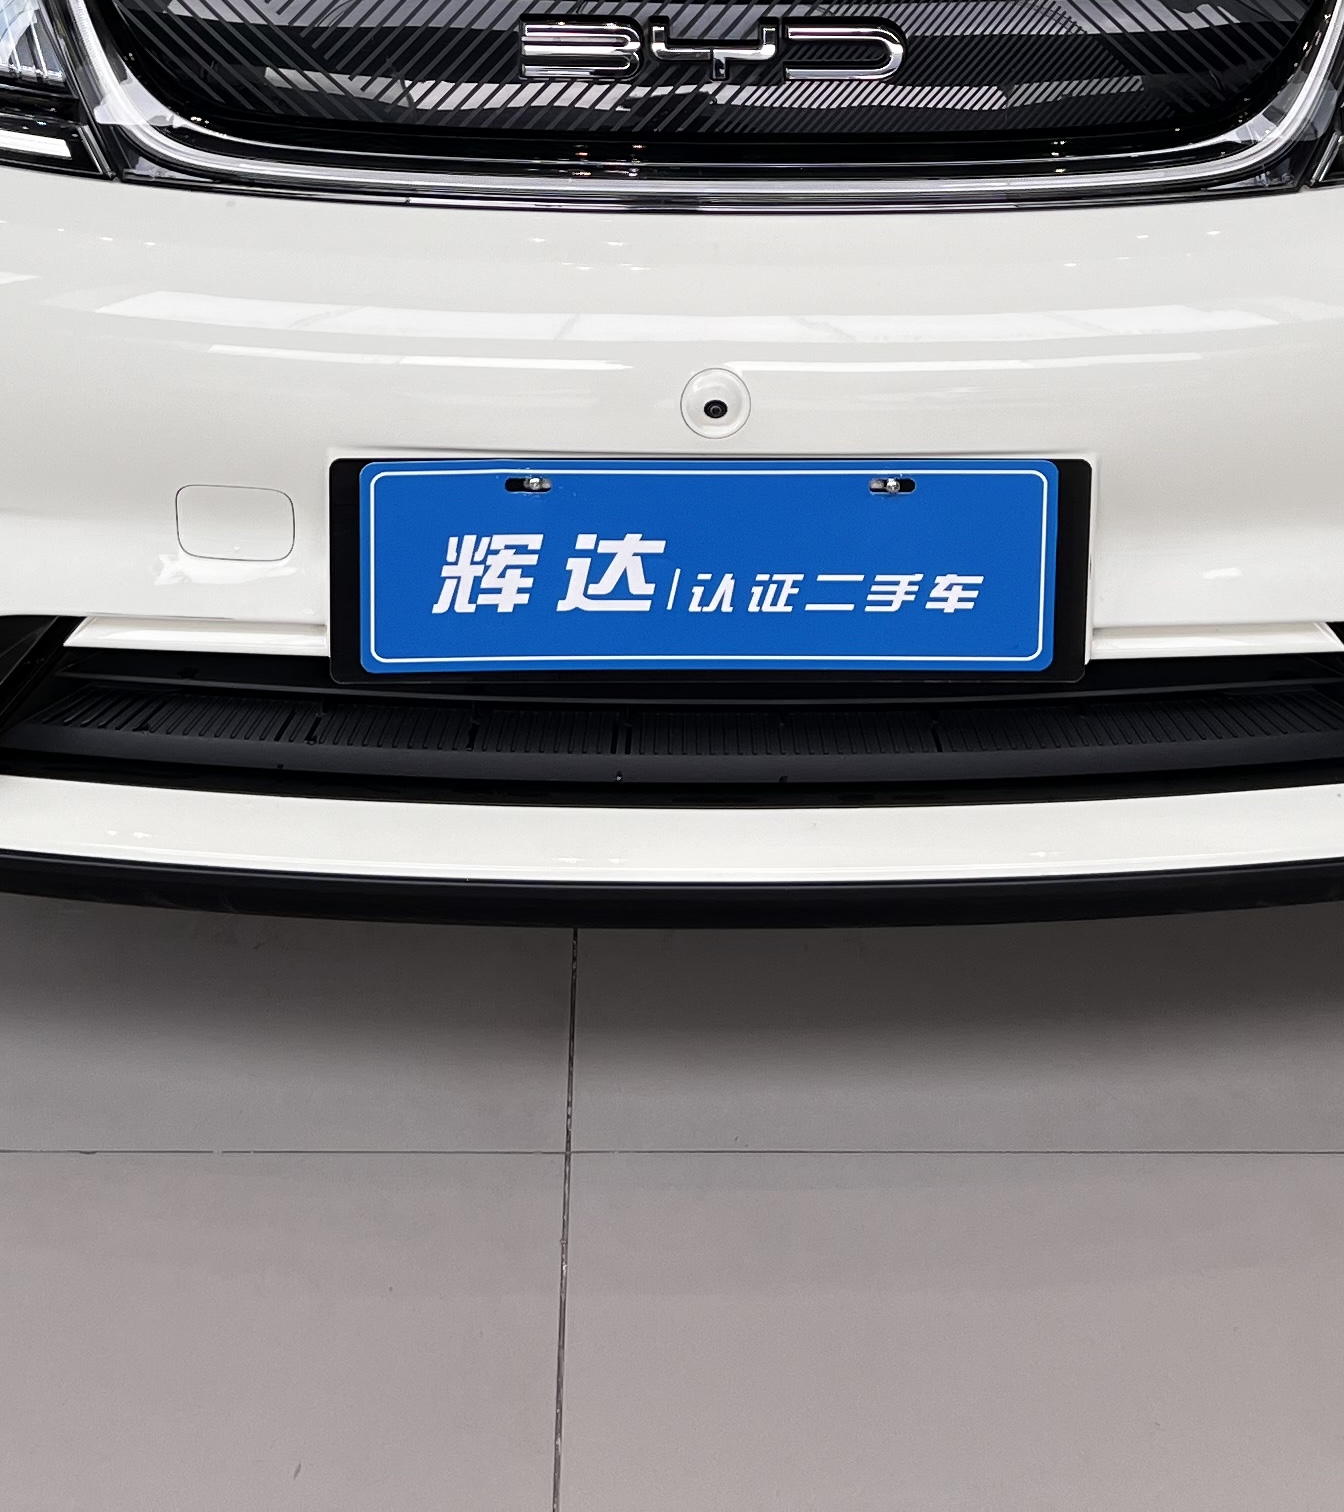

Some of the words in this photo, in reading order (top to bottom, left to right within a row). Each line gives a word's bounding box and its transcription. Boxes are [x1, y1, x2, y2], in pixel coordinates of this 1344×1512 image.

[520, 15, 907, 82] BYD
[432, 533, 666, 614] 辉达
[687, 572, 985, 614] 认证二手车
